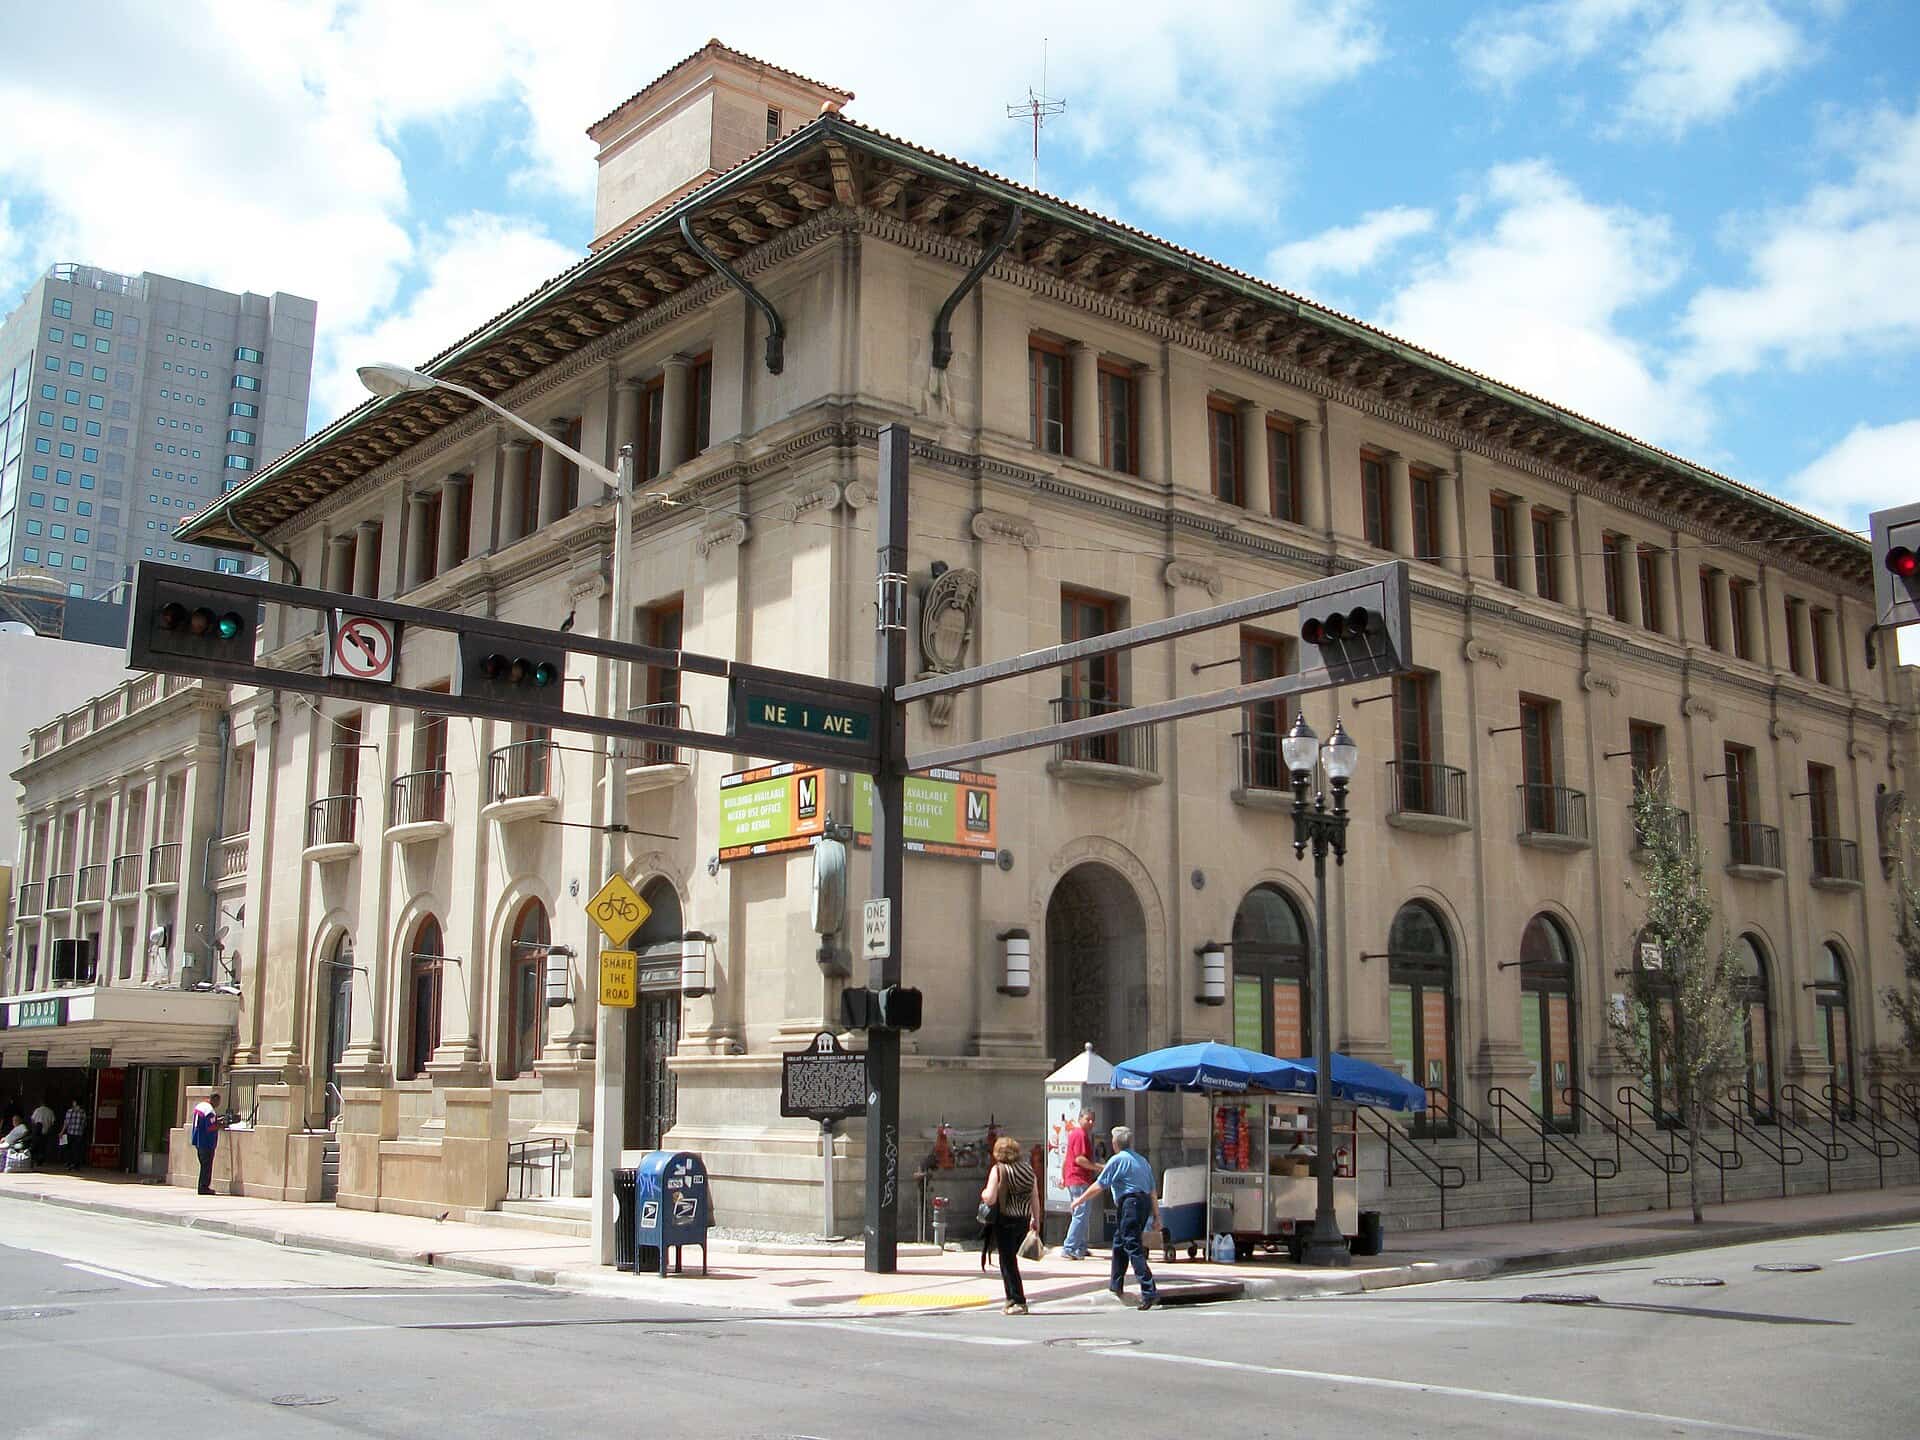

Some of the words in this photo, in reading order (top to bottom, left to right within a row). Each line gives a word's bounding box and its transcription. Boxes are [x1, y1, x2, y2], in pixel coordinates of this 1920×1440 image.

[764, 704, 787, 724] NE
[803, 711, 808, 728] 1
[823, 714, 853, 734] AVE
[907, 787, 948, 802] AVAILABLE
[760, 802, 781, 817] OFFICE
[916, 803, 943, 816] OFFICE
[866, 904, 885, 919] ONE
[866, 920, 886, 934] WAY
[603, 957, 633, 970] SHARE
[610, 973, 627, 985] THE
[606, 988, 630, 1000] ROAD
[1202, 1074, 1247, 1089] downtown
